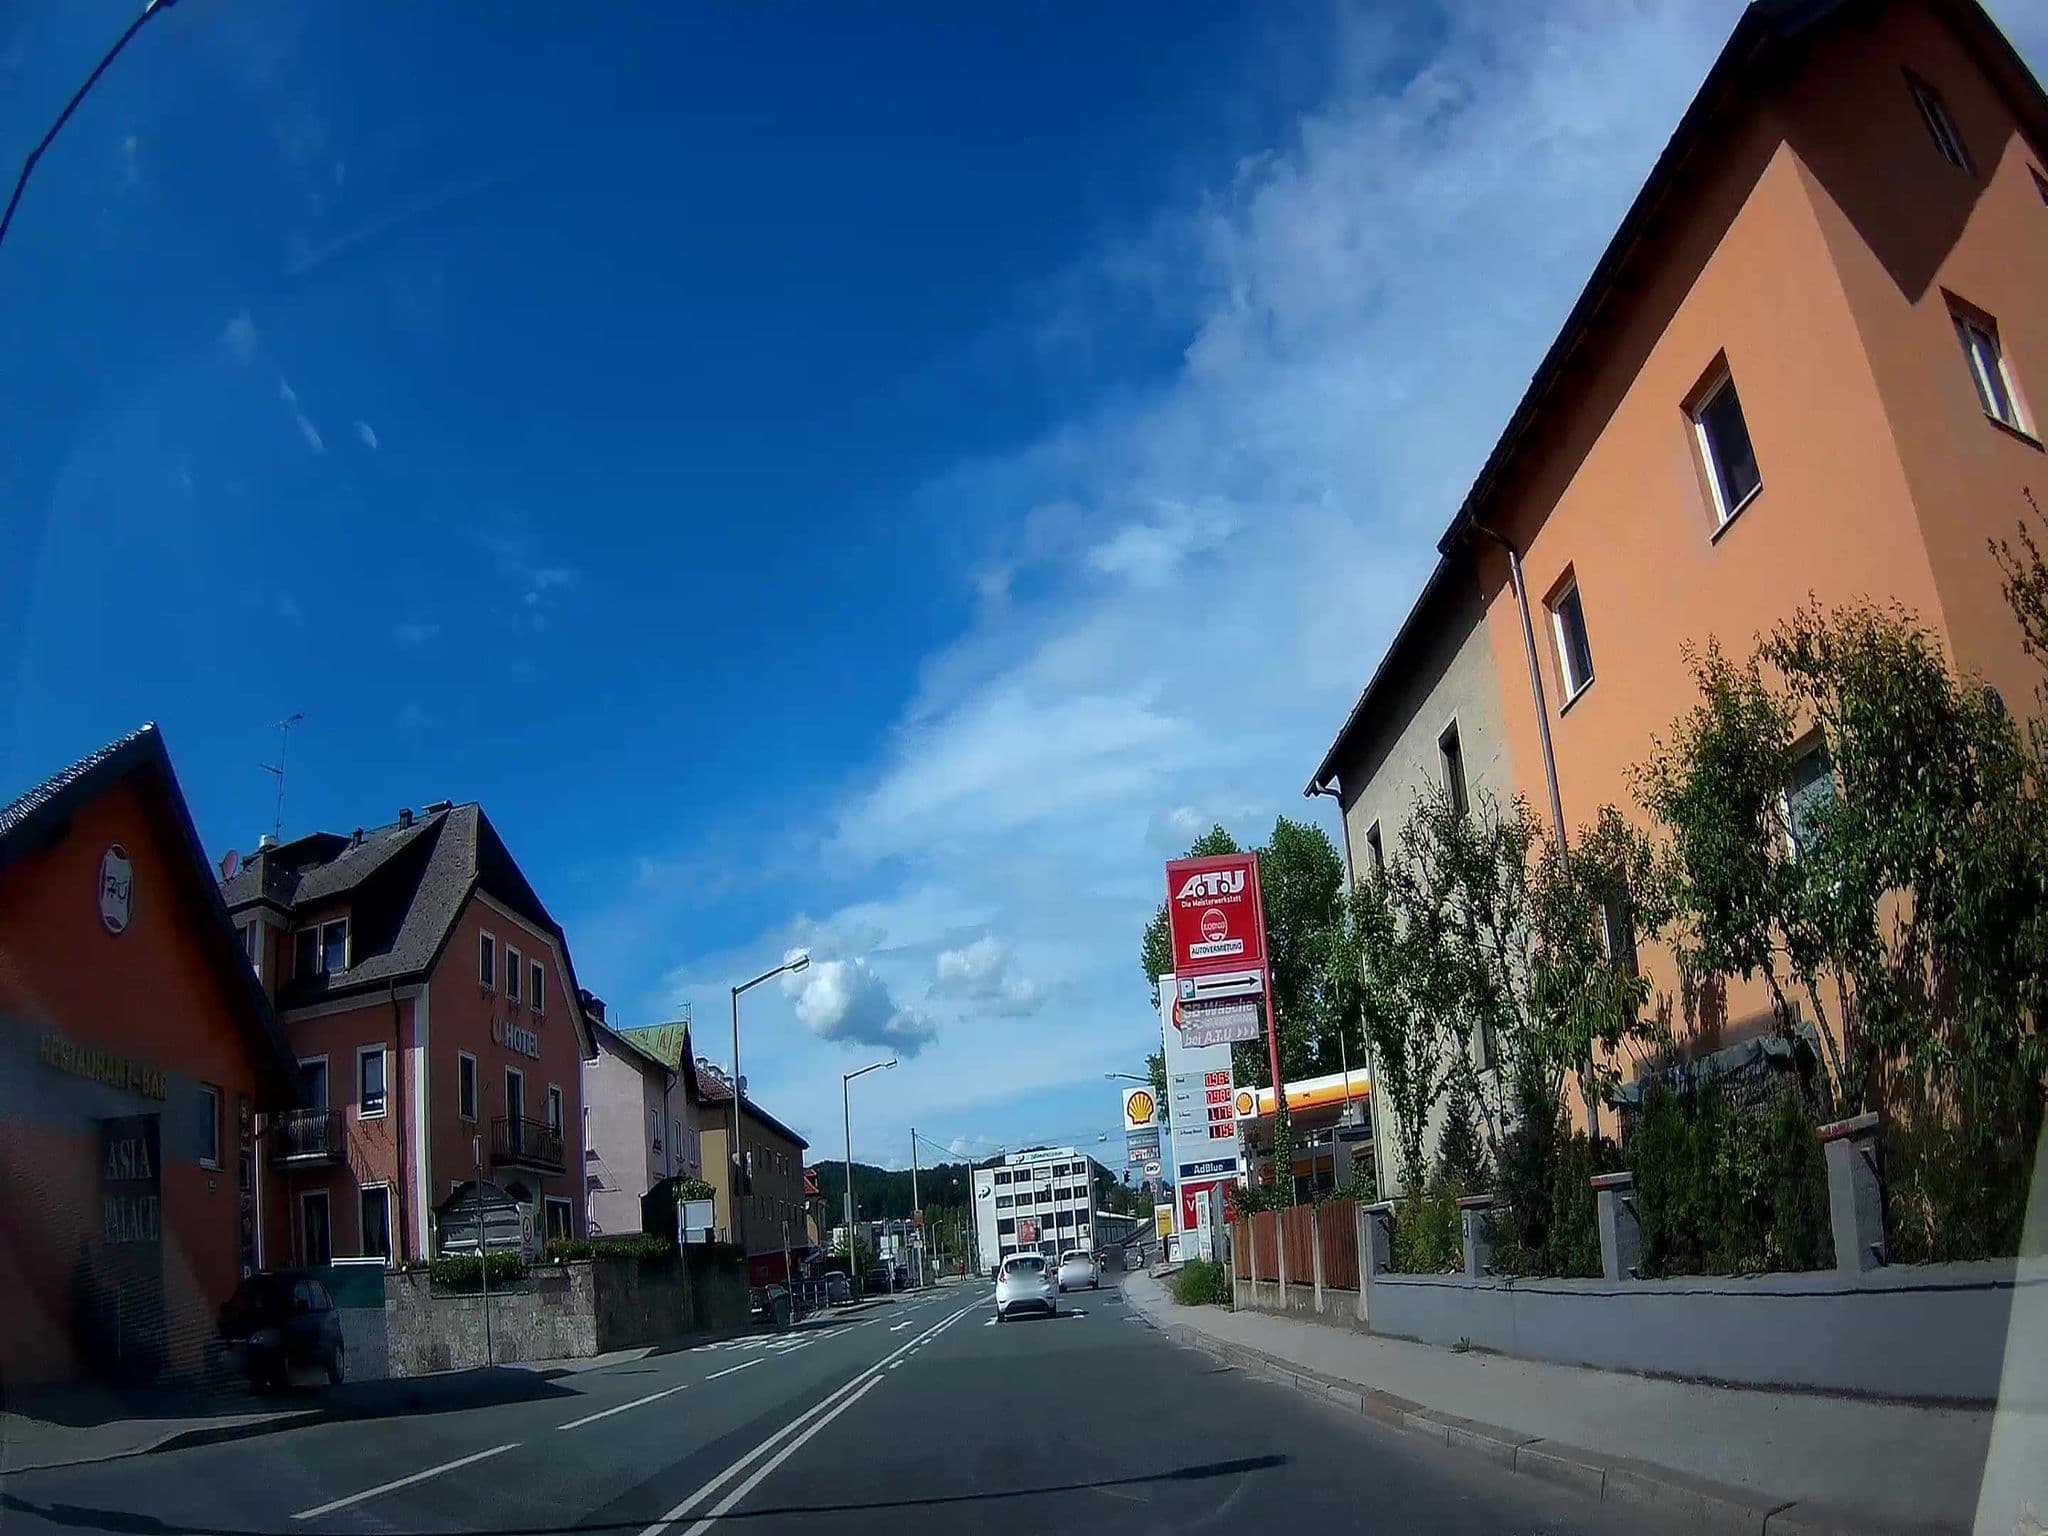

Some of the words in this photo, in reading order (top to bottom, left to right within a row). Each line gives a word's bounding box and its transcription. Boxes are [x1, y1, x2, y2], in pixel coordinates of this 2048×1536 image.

[1181, 900, 1192, 909] Die
[1192, 895, 1242, 908] Meisterwerkstatt
[1191, 942, 1242, 956] AUTOVERMIETUNG
[506, 1022, 541, 1059] HOTEL
[104, 1137, 154, 1180] ASIA
[1193, 1162, 1224, 1175] AdBlue
